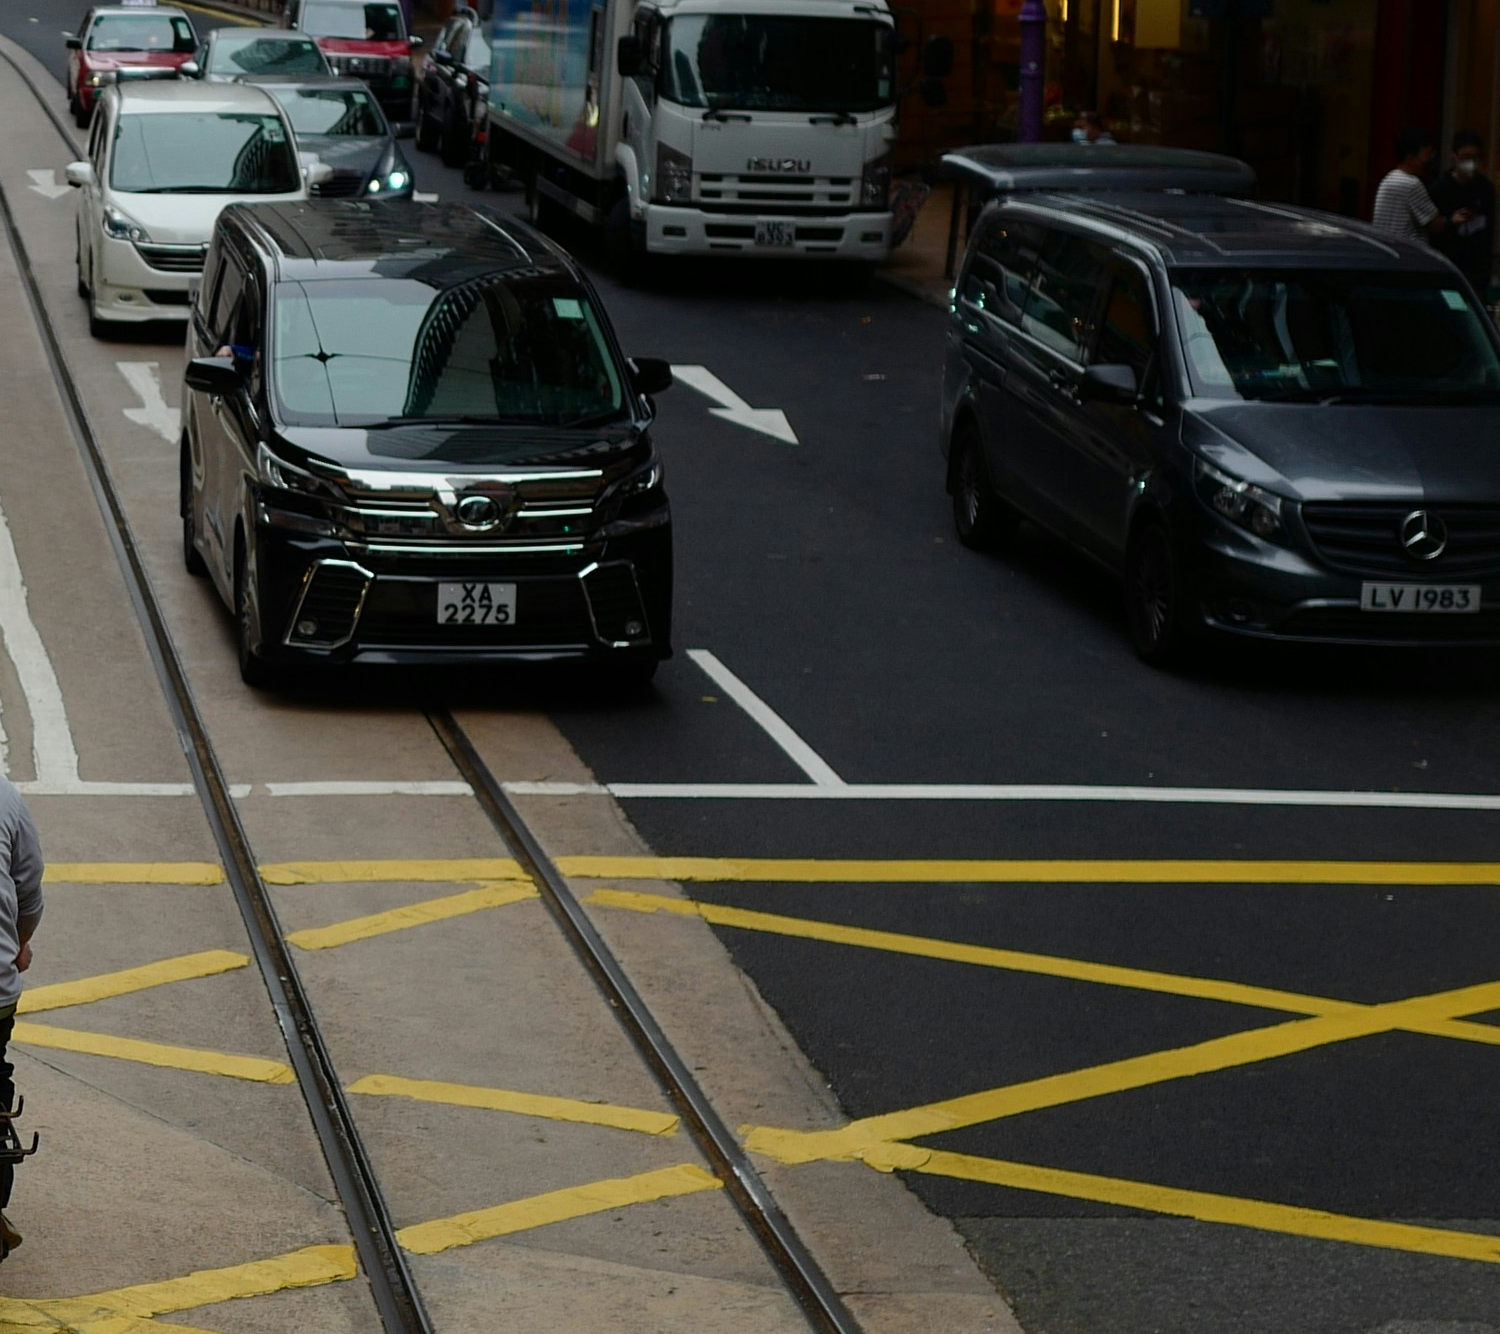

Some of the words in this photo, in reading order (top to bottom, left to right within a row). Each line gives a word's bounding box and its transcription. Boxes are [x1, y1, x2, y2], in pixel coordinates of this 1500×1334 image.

[747, 157, 811, 173] ISUZU
[462, 582, 492, 604] XA
[1371, 588, 1404, 608] LV
[1415, 588, 1470, 609] 1983
[444, 603, 510, 624] 2275
